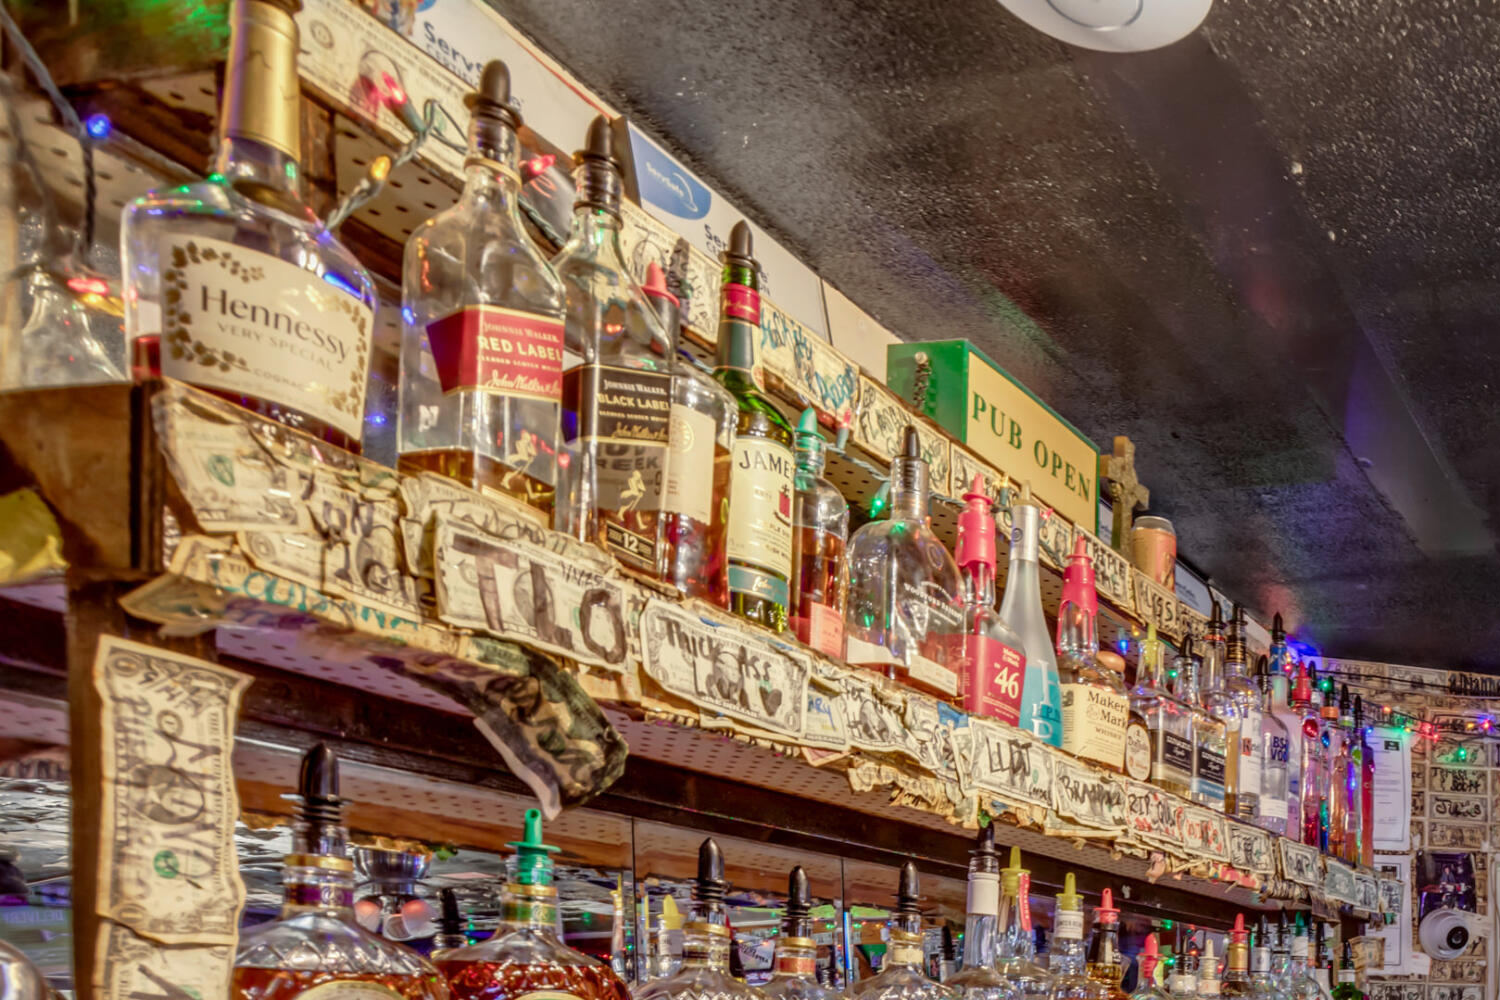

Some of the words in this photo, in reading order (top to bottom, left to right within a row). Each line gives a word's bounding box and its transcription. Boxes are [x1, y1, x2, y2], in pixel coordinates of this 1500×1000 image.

[201, 284, 350, 364] Hennessy
[217, 320, 264, 342] VERY
[268, 336, 334, 372] SPECIAL
[477, 335, 514, 353] RED
[516, 341, 563, 362] LABEL
[597, 393, 636, 407] BLACK
[636, 397, 671, 411] LABEL
[971, 390, 1023, 451] PUB
[1033, 438, 1092, 503] OPEN
[738, 448, 793, 480] JAME
[622, 533, 639, 552] 12
[993, 665, 1020, 700] 46
